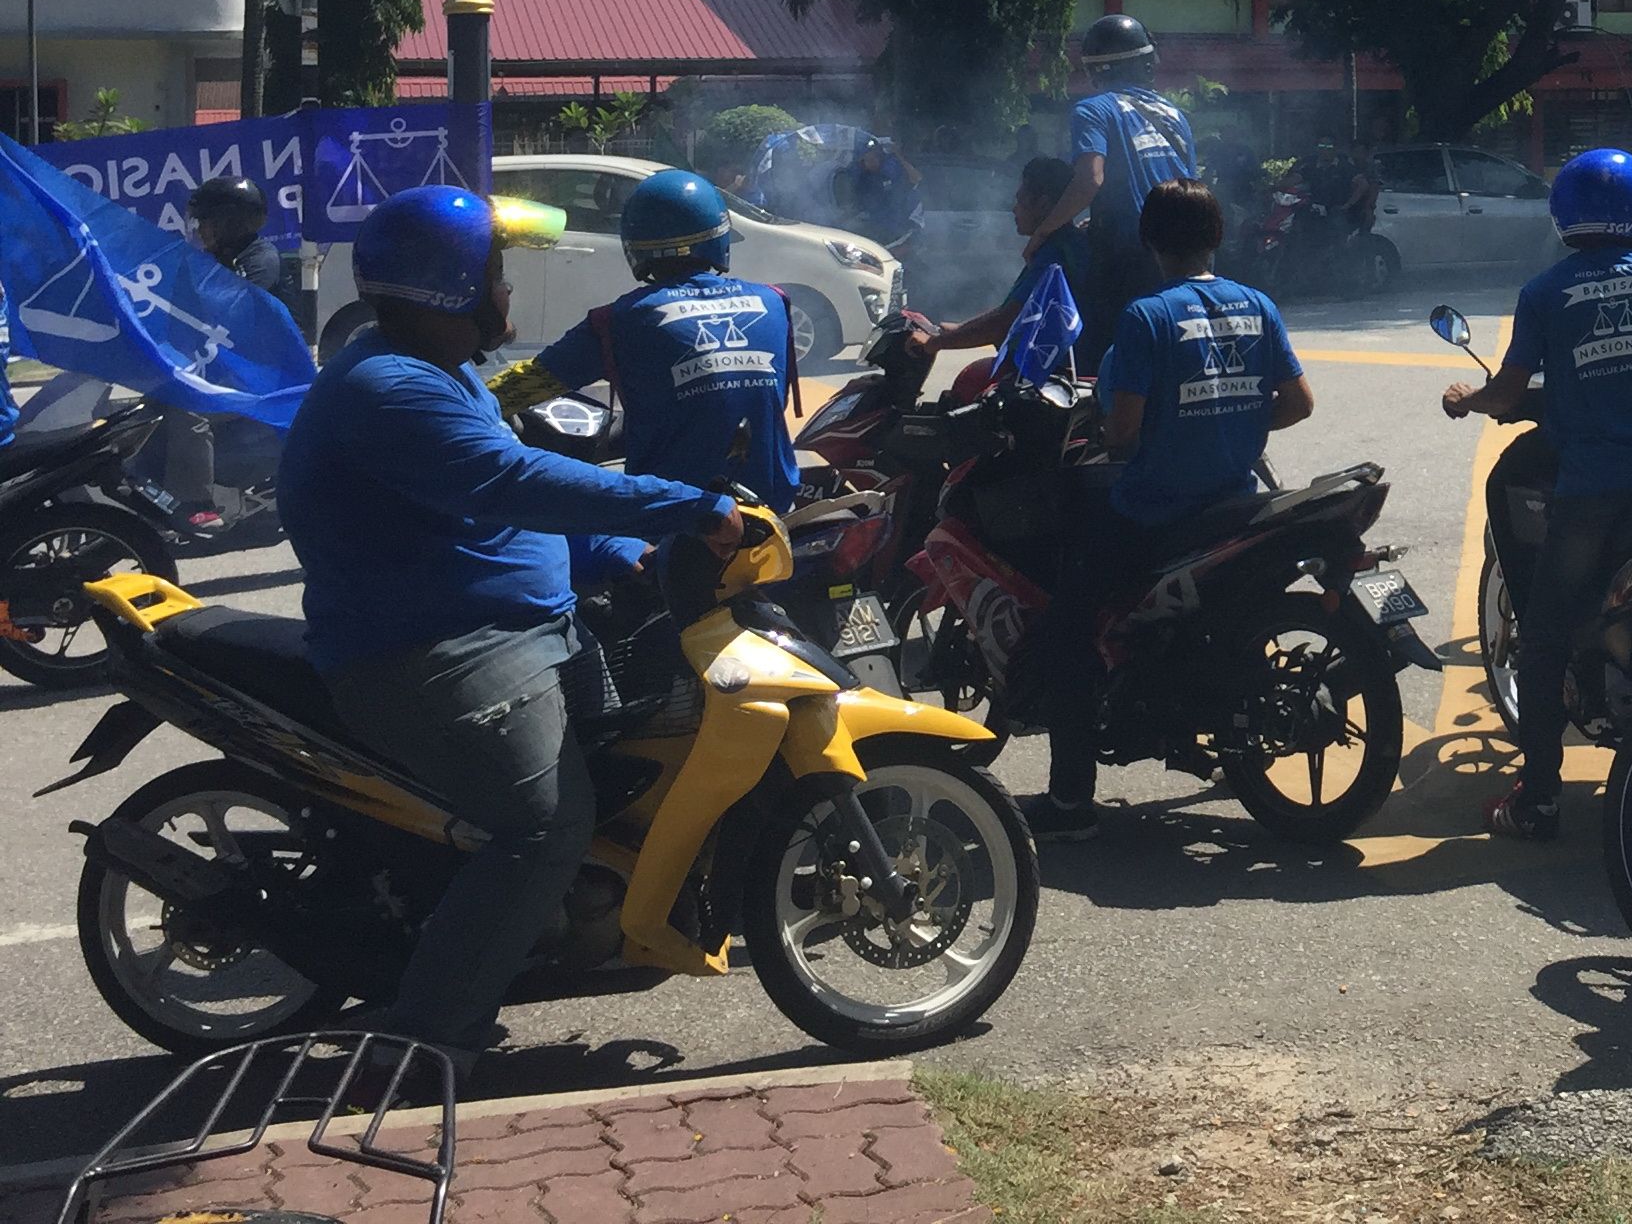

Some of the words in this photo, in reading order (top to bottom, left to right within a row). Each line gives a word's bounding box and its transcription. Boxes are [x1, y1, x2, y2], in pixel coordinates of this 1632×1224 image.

[667, 287, 701, 298] HIDUP
[704, 284, 743, 296] RAKYAT
[679, 298, 752, 314] BARISAN
[679, 355, 765, 378] NASIONAL
[744, 378, 779, 389] RAKYAT
[1187, 380, 1255, 398] NASIONAL
[1373, 593, 1416, 614] 5190
[836, 600, 878, 628] AKM
[840, 624, 882, 647] 9121
